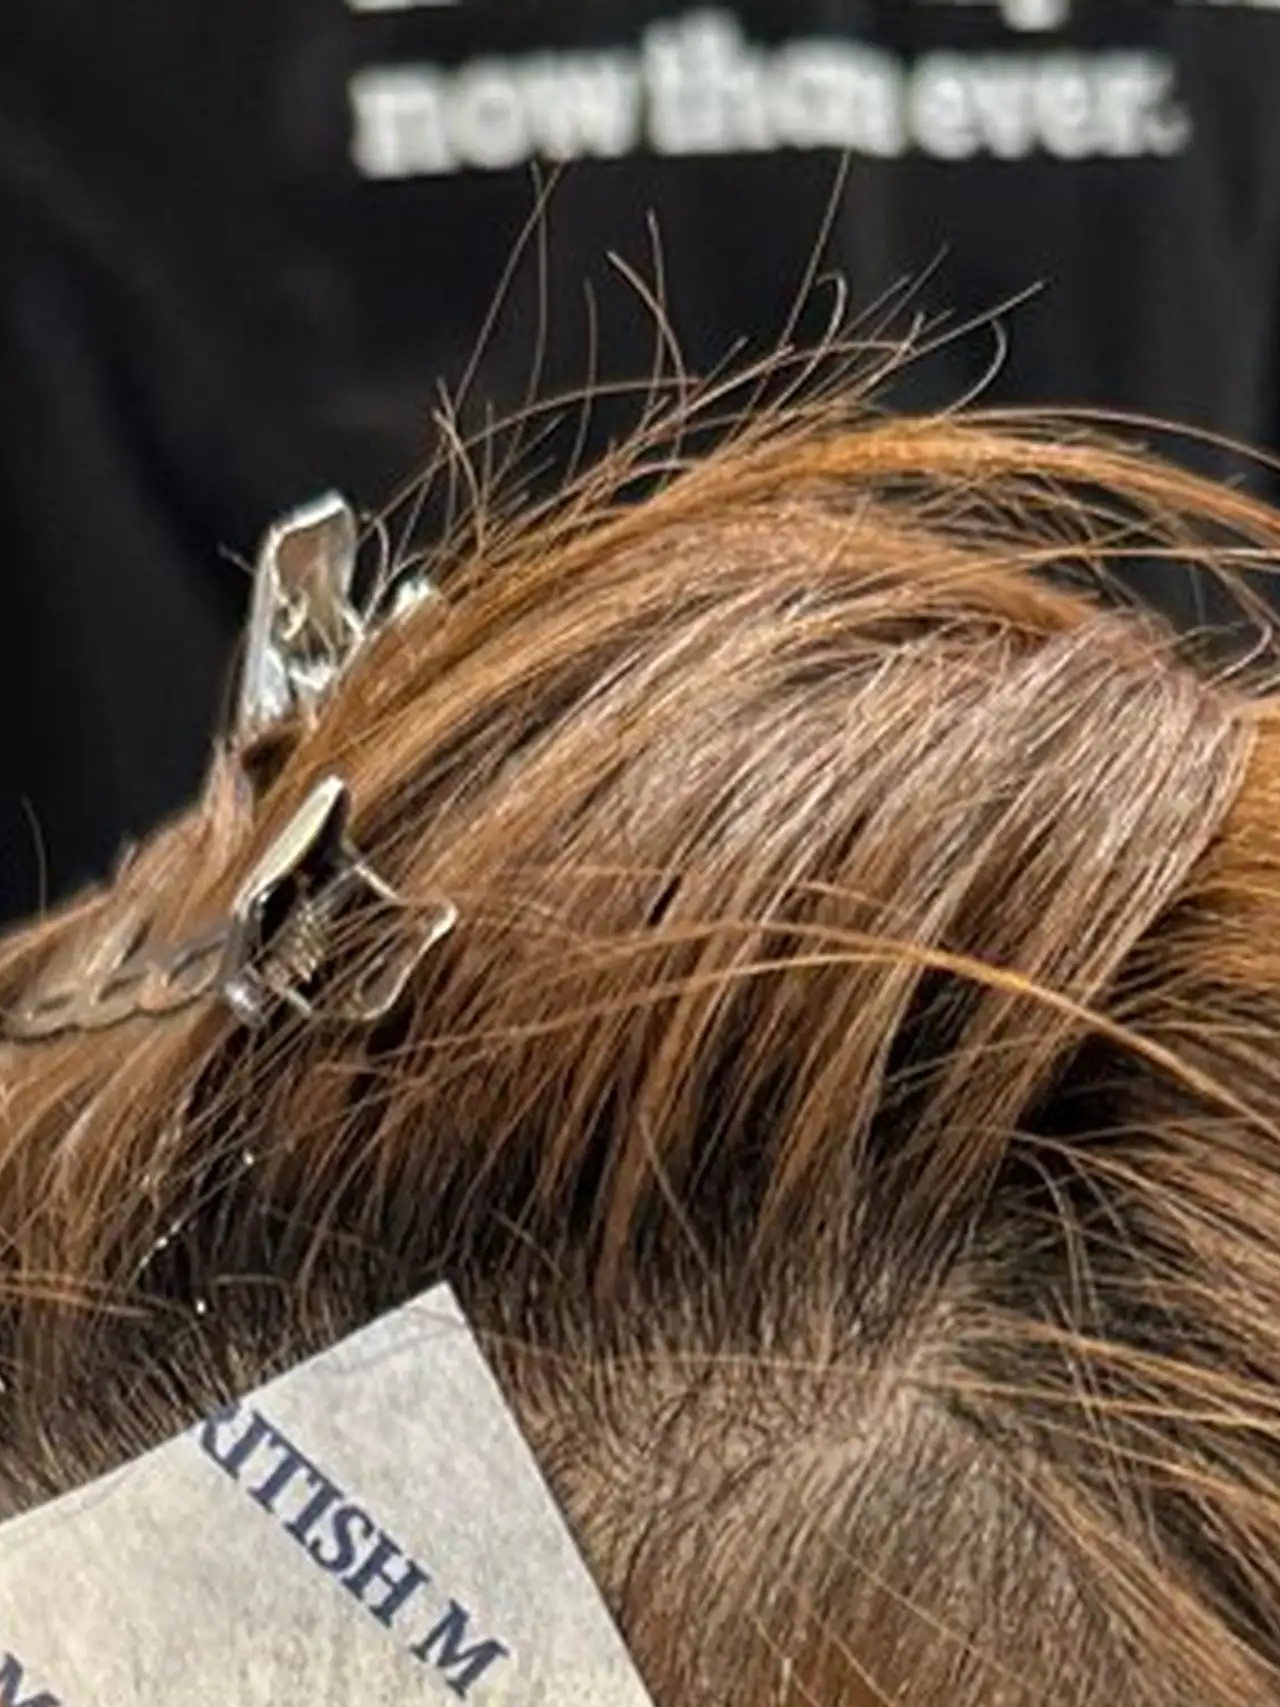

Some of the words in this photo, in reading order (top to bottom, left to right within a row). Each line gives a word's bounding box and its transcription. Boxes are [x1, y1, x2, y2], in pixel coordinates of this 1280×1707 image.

[350, 64, 640, 178] now
[642, 8, 910, 158] than
[912, 50, 1192, 160] ever.
[410, 1599, 510, 1700] M
